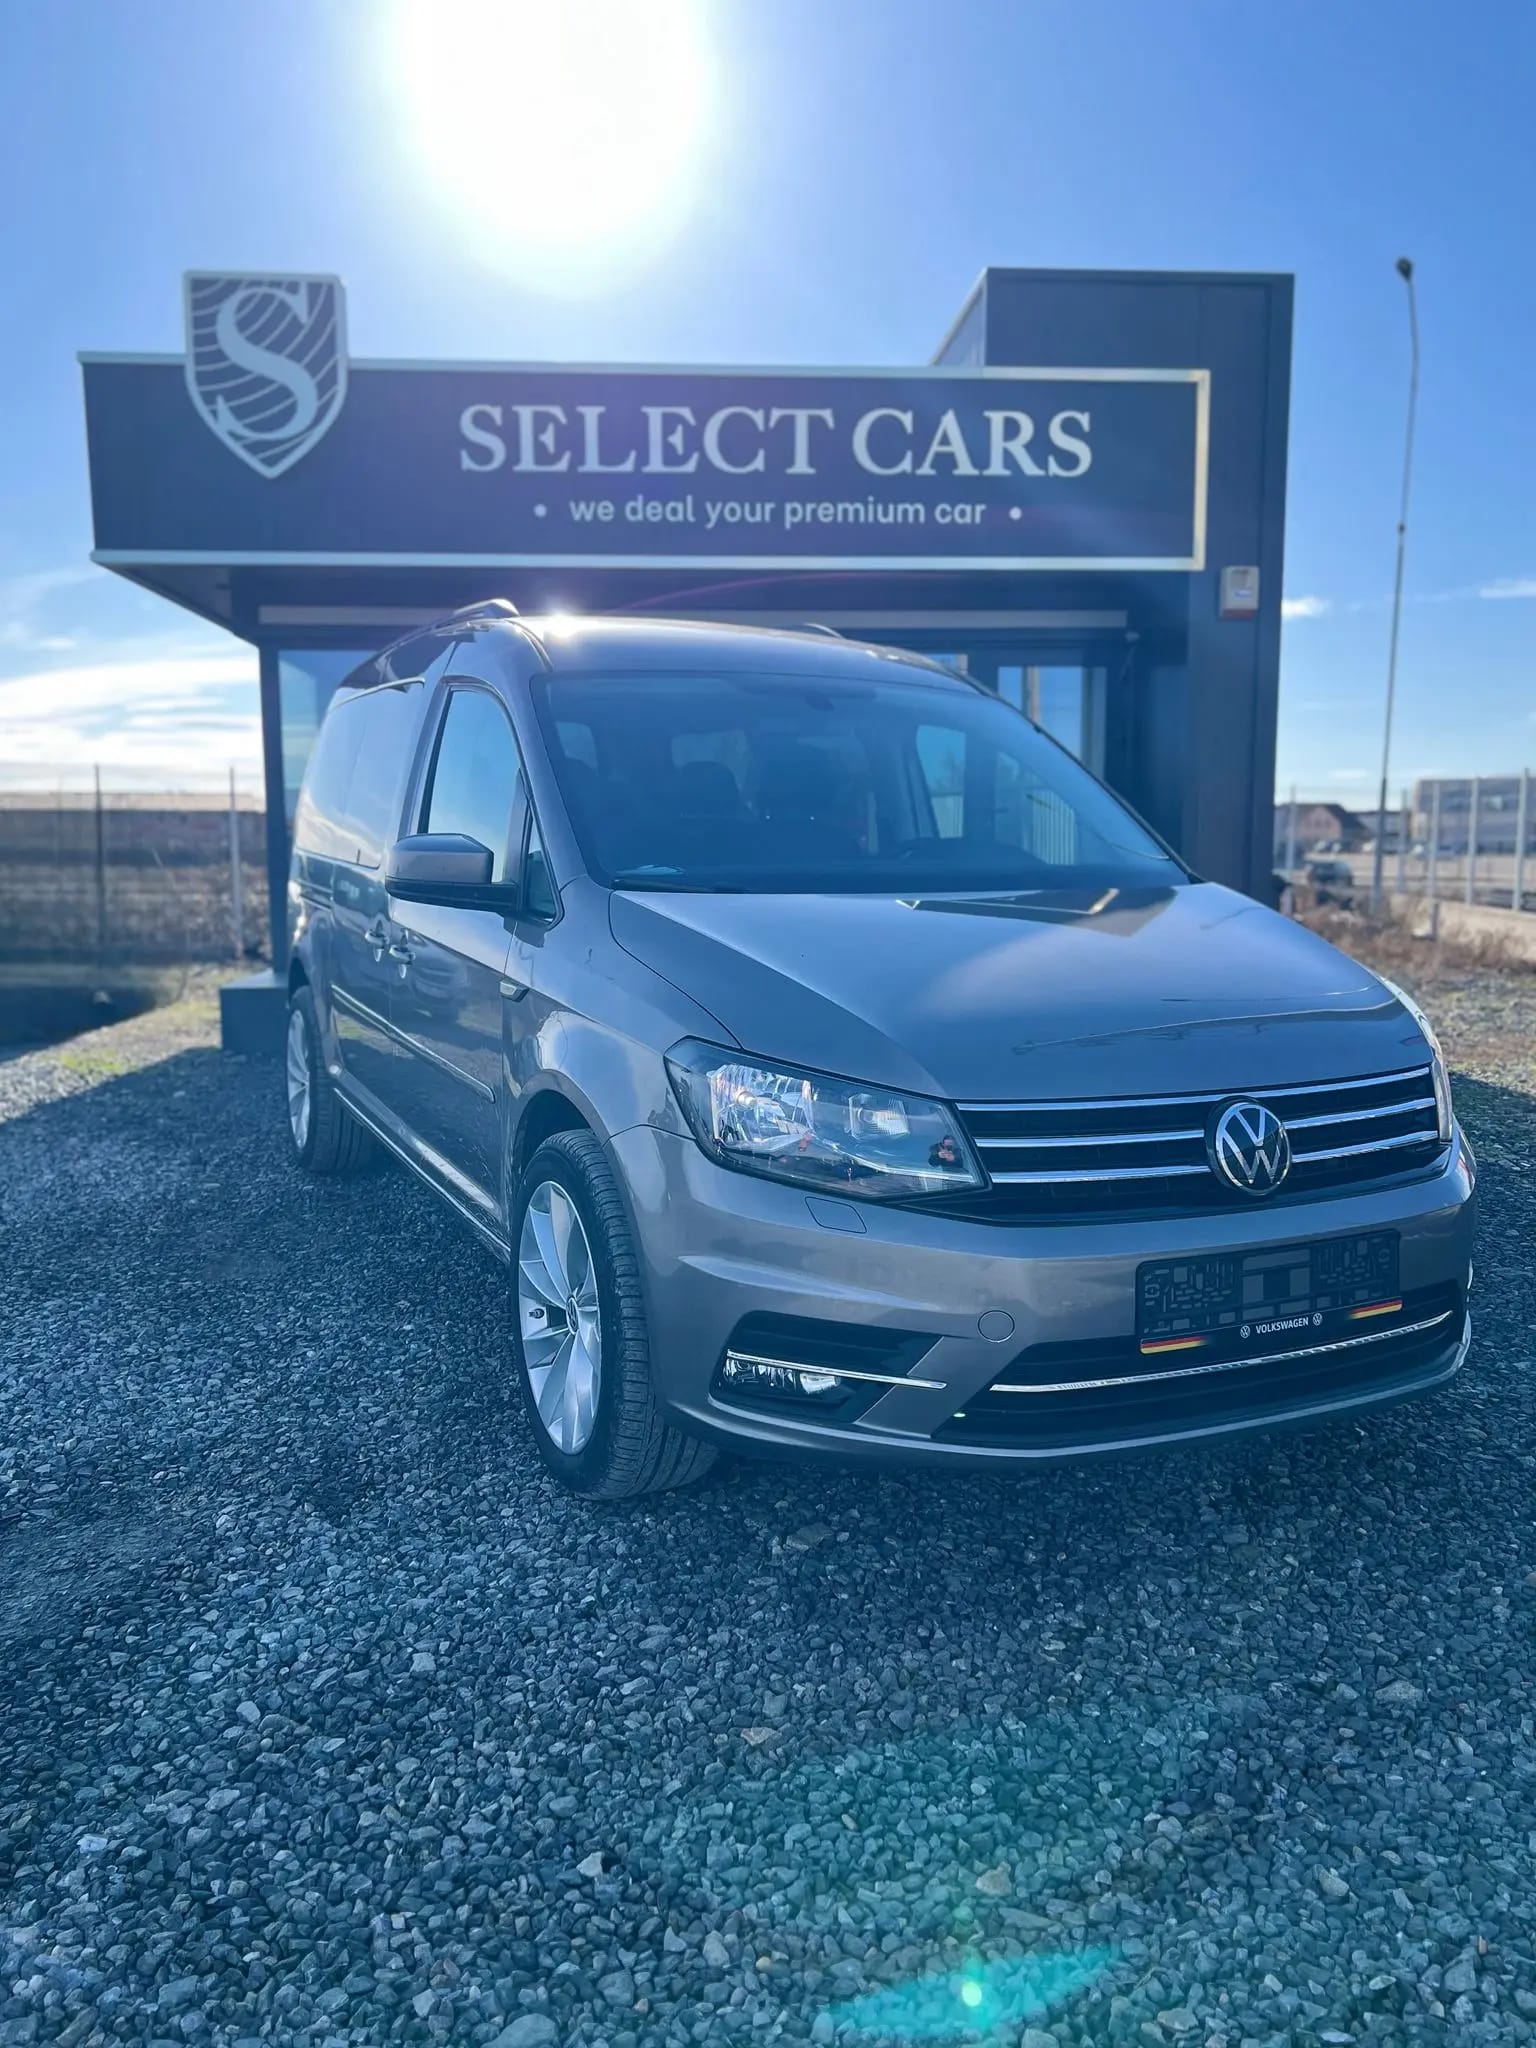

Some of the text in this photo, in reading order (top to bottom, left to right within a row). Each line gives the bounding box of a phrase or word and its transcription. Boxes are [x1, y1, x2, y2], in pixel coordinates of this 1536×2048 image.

[214, 287, 319, 439] S
[458, 403, 1093, 478] SELECT CARS
[568, 495, 986, 530] we deal your premium car
[1255, 1317, 1309, 1334] VOLKSWAGEN
